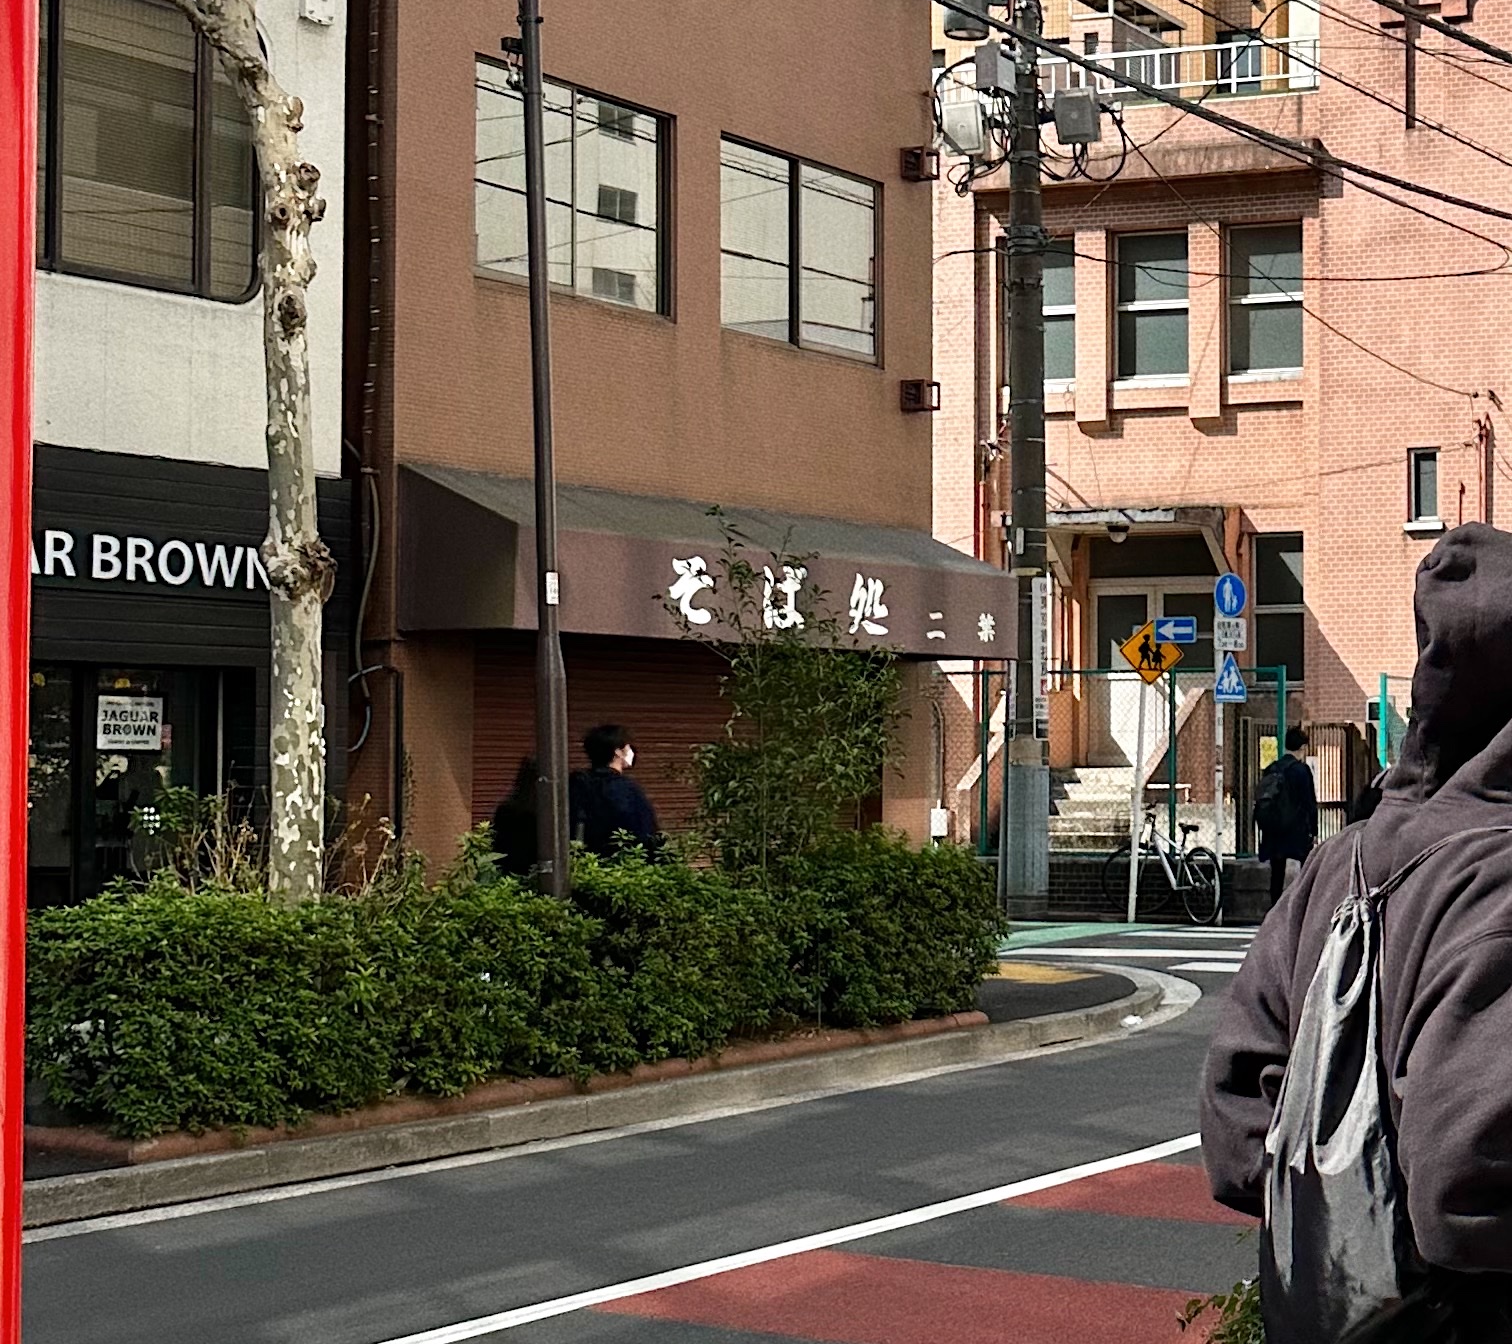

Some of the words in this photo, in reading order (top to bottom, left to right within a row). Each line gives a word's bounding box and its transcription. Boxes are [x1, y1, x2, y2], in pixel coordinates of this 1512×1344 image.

[91, 534, 272, 591] BROWN
[668, 555, 890, 637] そば処
[101, 710, 158, 724] JAGUAR
[102, 723, 156, 736] BROWN
